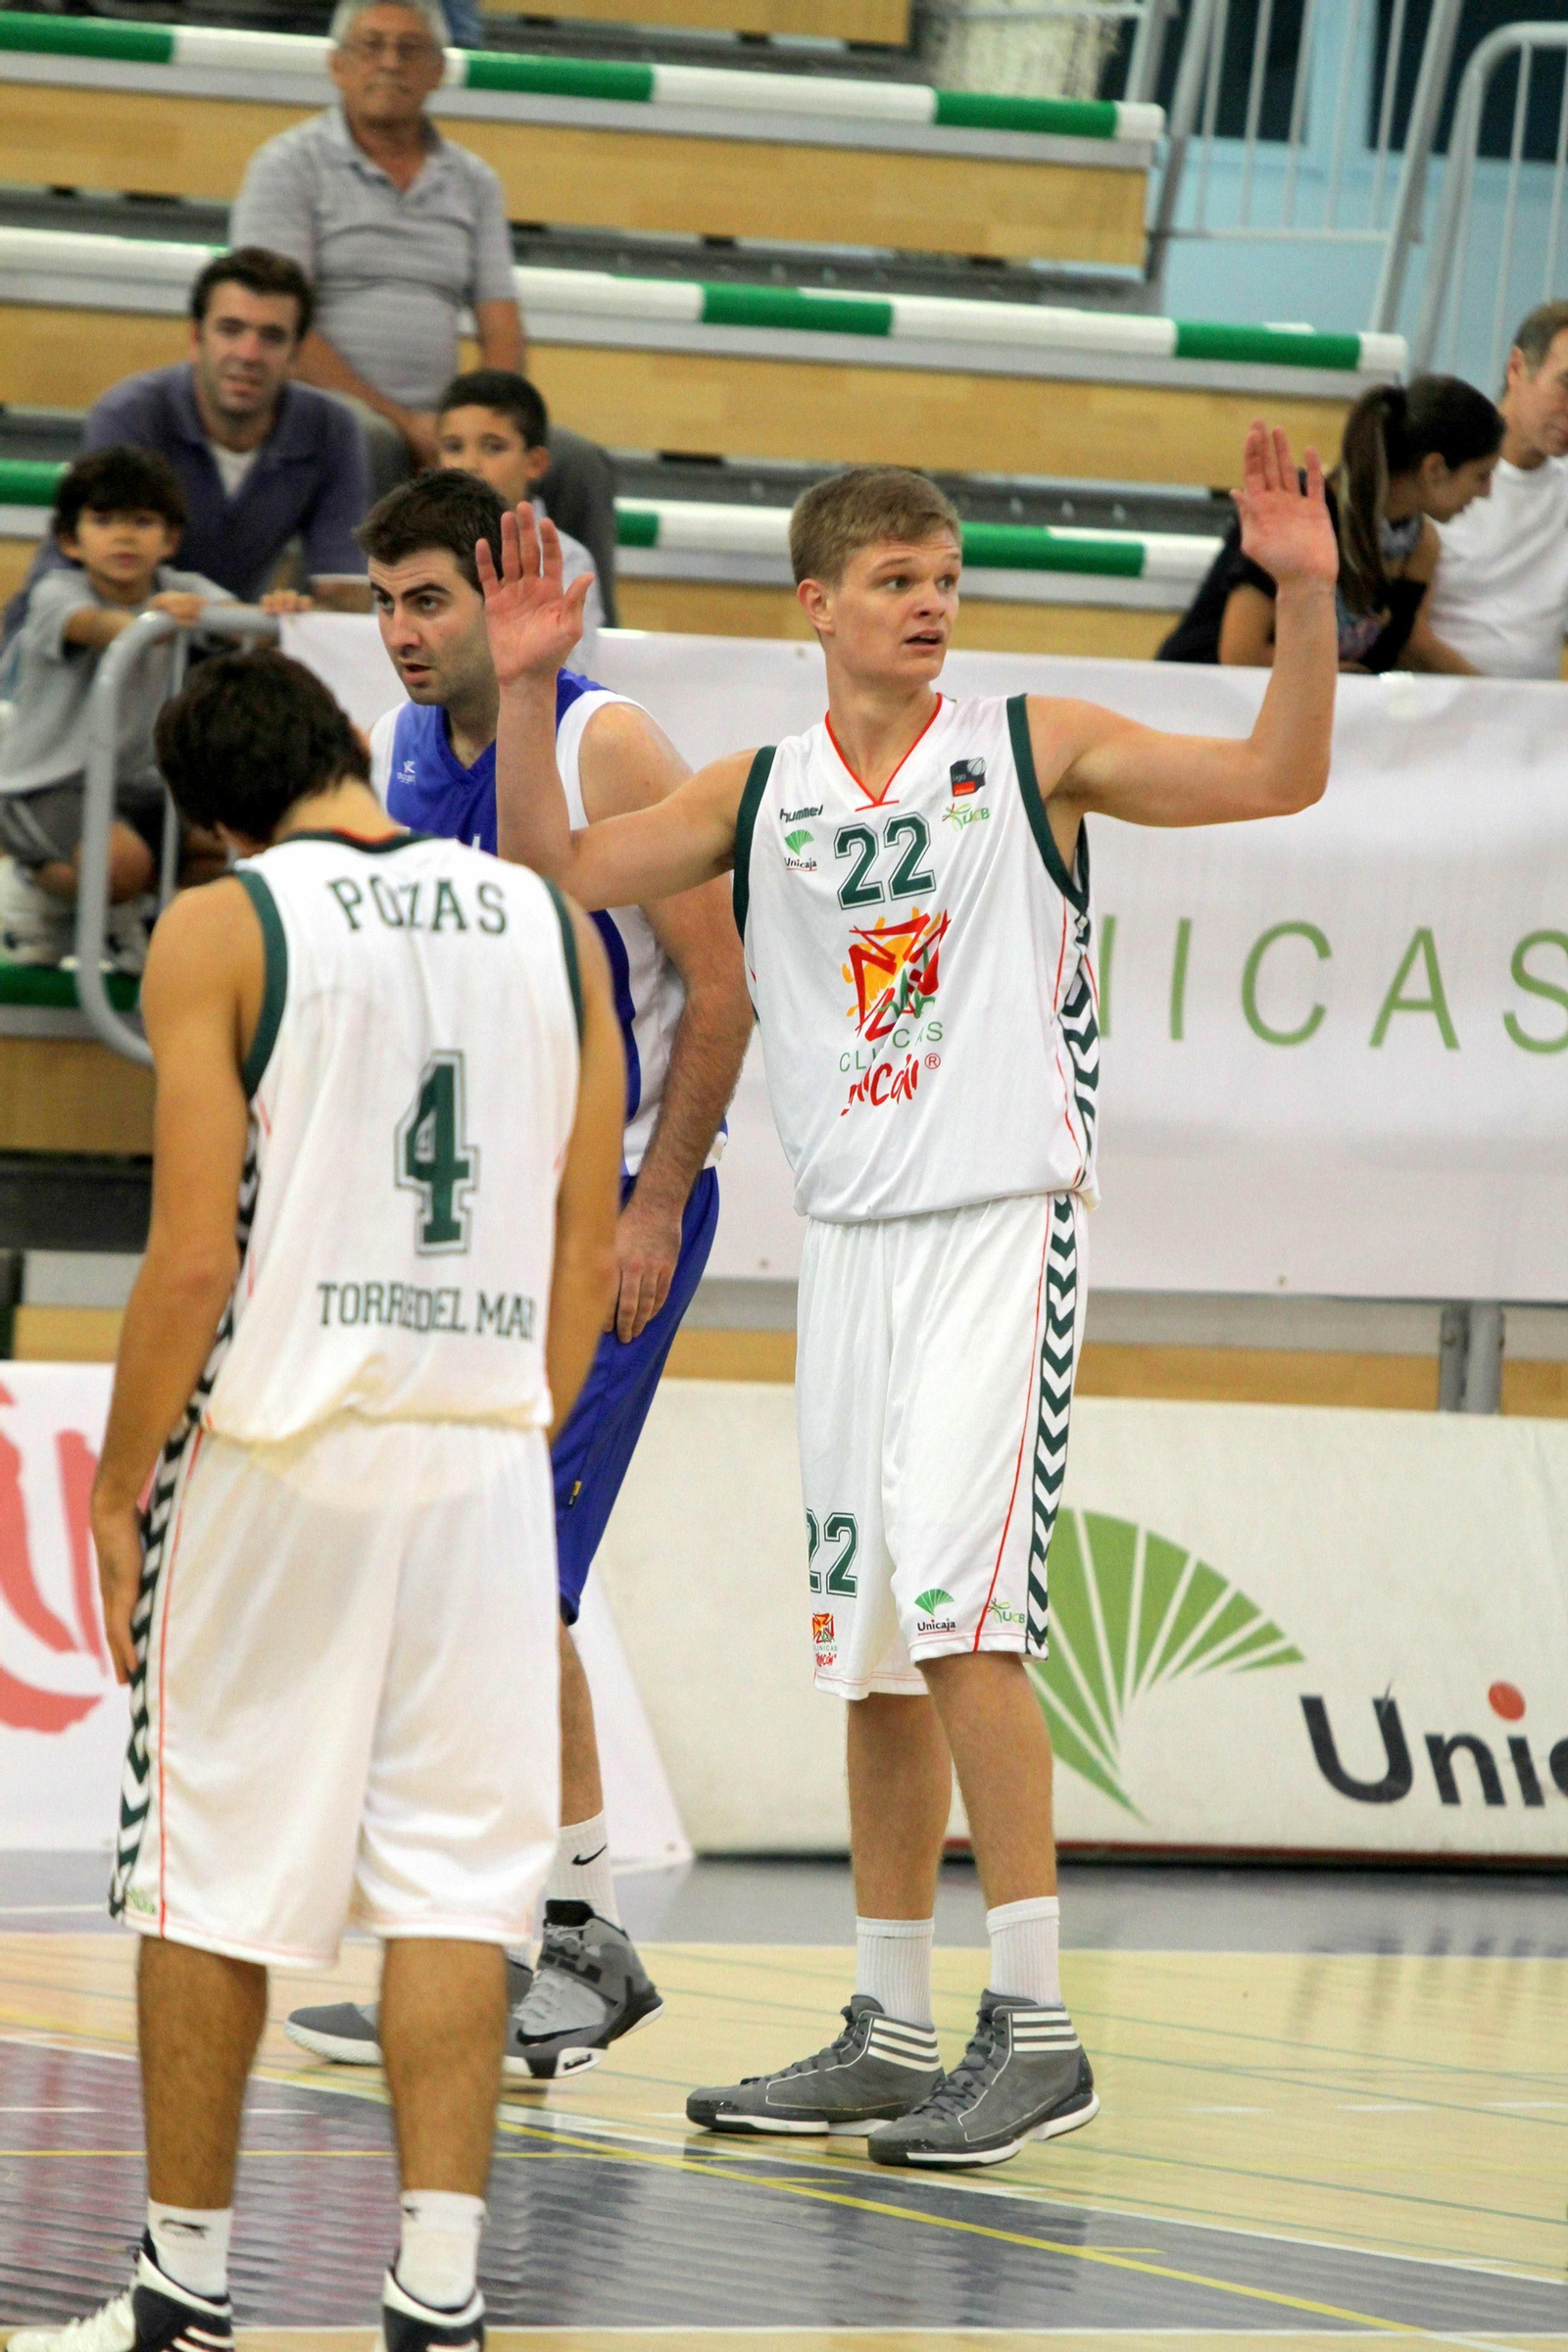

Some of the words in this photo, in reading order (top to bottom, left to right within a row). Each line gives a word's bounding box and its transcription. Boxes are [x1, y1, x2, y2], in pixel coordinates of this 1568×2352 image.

[779, 804, 823, 823] hummel
[833, 811, 936, 910] 22
[394, 1048, 479, 1255] 4
[917, 1618, 956, 1633] Unicaja
[1003, 1610, 1025, 1624] UCB
